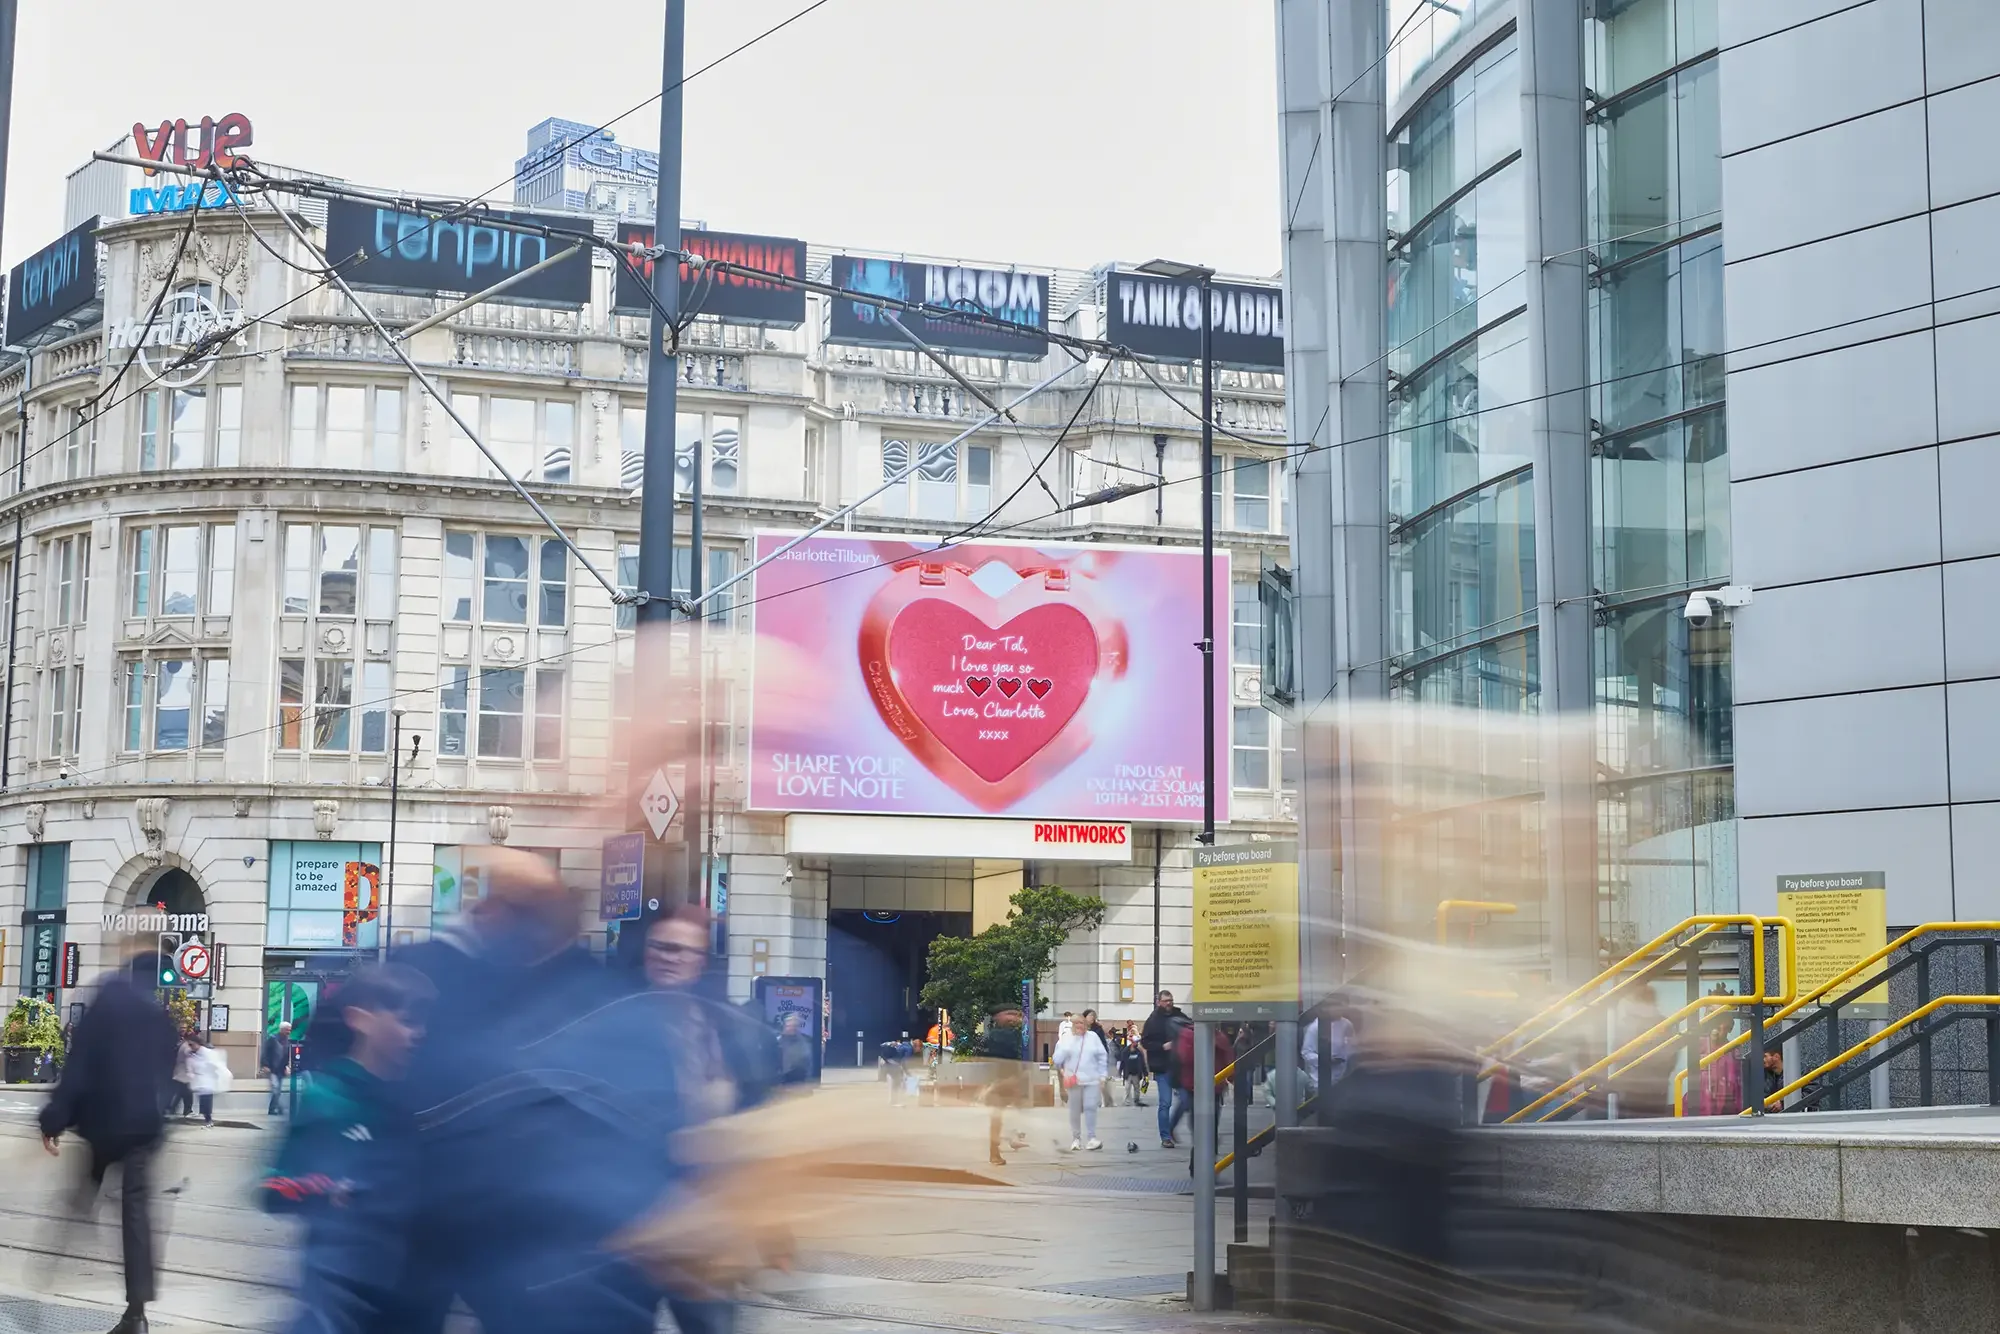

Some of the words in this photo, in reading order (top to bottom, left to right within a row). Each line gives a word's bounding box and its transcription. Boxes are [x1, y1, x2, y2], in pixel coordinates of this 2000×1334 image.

[129, 178, 245, 215] IMAX
[1119, 280, 1180, 328] TANK
[1211, 290, 1284, 338] PADDL
[962, 635, 997, 651] Dear
[1000, 636, 1028, 654] Tal,
[952, 655, 956, 671] I
[960, 656, 988, 672] love
[992, 664, 1014, 677] you
[1019, 666, 1034, 674] so
[932, 679, 964, 694] much
[943, 701, 979, 719] Love,
[984, 702, 1046, 718] Charlotte
[978, 730, 1009, 740] xxxx
[772, 754, 841, 774] SHARE
[846, 756, 905, 776] YOUR
[1114, 764, 1146, 778] FIND
[1148, 766, 1166, 778] US
[1168, 766, 1184, 779] AT
[777, 776, 836, 798] LOVE
[840, 778, 907, 800] NOTE
[1086, 778, 1161, 792] EXCHANGE
[1095, 792, 1128, 805] 19TH
[1140, 794, 1172, 807] 21ST
[1034, 824, 1126, 844] PRINTWORKS
[1199, 853, 1212, 865] Pay
[1212, 850, 1236, 863] before
[1236, 852, 1250, 864] you
[1250, 849, 1272, 860] board
[296, 860, 339, 870] prepare
[296, 872, 307, 880] to
[310, 872, 324, 880] be
[1785, 880, 1799, 890] Pay
[1800, 878, 1824, 888] before
[1826, 879, 1840, 889] you
[1840, 876, 1862, 886] board
[295, 883, 337, 892] amazed
[620, 890, 639, 900] BOTH
[100, 912, 209, 936] wagamama
